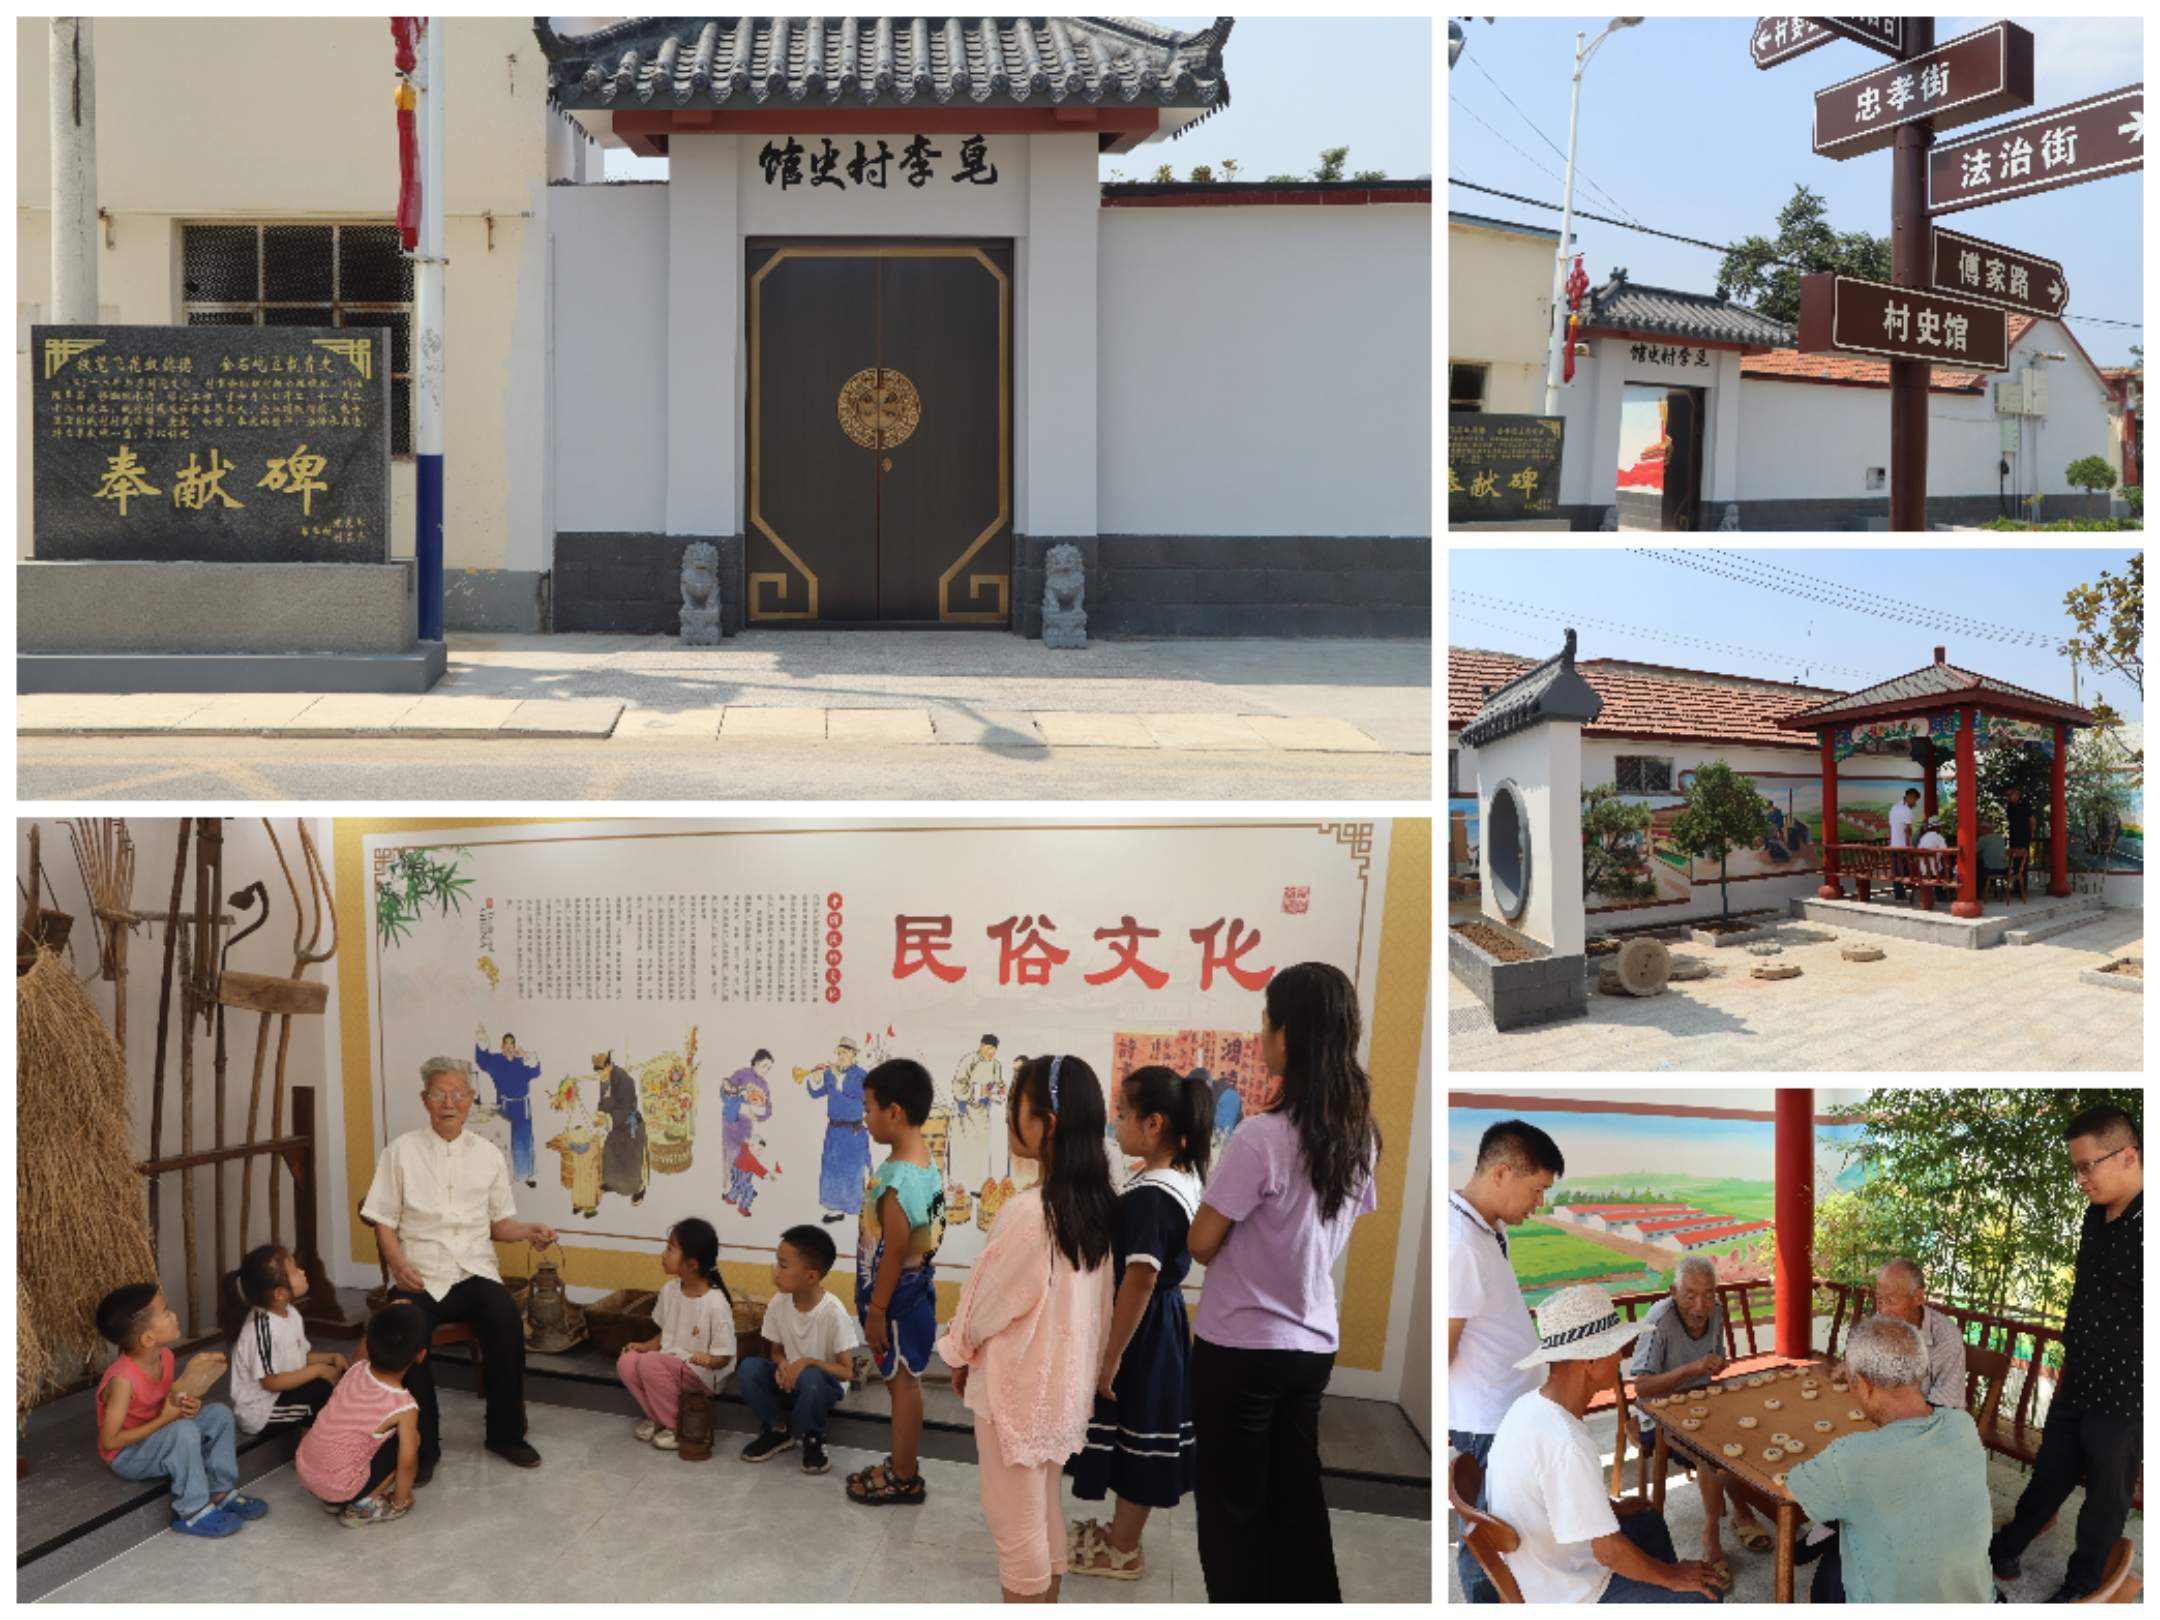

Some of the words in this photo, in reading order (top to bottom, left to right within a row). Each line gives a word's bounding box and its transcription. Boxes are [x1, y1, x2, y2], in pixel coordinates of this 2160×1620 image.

[1855, 62, 1950, 122] 忠孝街
[1961, 126, 2079, 189] 法治街
[1958, 250, 2028, 301] 傅家路
[1882, 299, 1969, 352] 村史馆
[93, 445, 328, 516] 奉献碑
[892, 914, 1277, 992] 民俗文化
